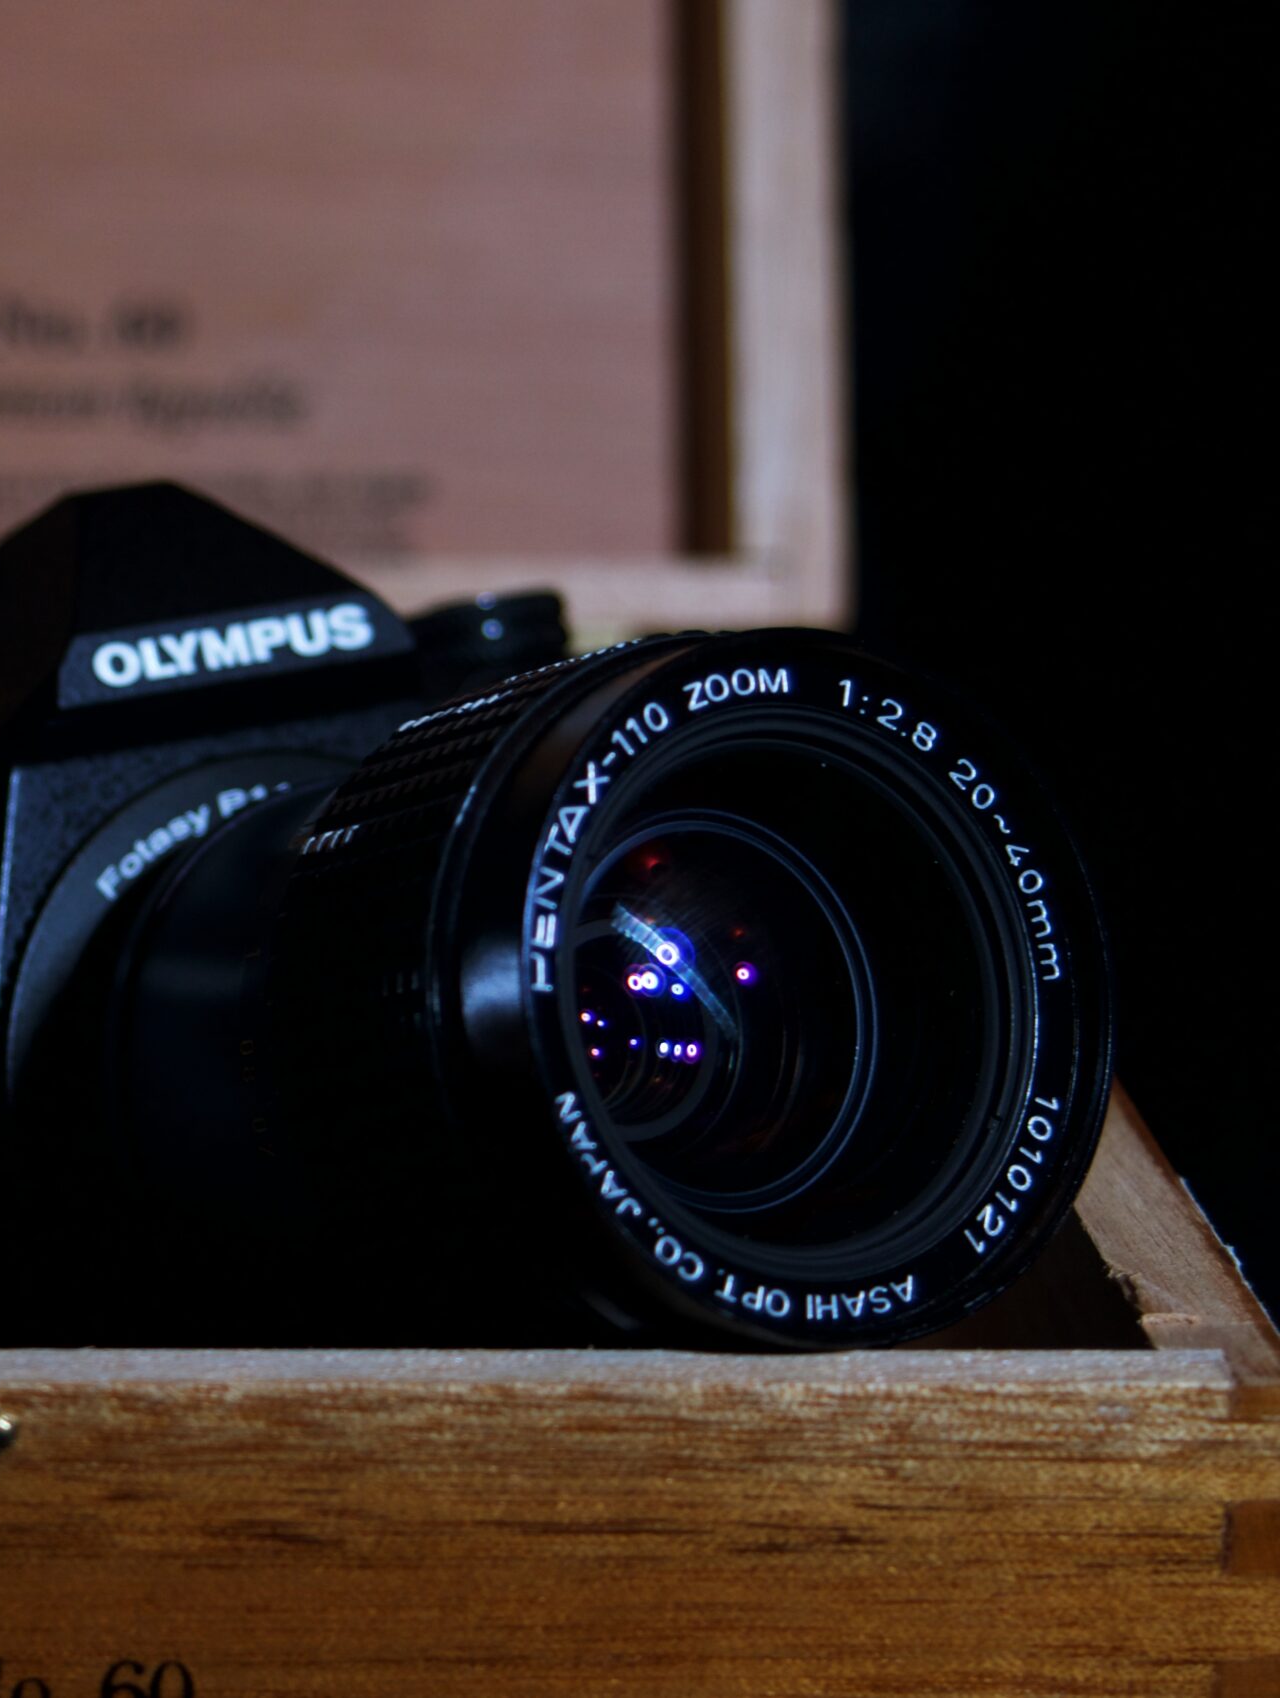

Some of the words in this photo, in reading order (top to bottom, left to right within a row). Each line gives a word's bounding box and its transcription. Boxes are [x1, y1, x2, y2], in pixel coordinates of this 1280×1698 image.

[92, 603, 376, 690] OLYMPUS
[95, 802, 212, 900] Fotasy
[529, 701, 671, 992] PENTAX-110
[681, 666, 790, 712] ZOOM
[837, 678, 938, 753] 1:2.8
[946, 757, 1062, 983] 20~40mm
[553, 1089, 643, 1217] JAPAN
[962, 1095, 1060, 1256] 1010121
[713, 1268, 792, 1318] OPT.
[804, 1273, 918, 1321] ASAHI
[100, 1659, 196, 1698] 60
